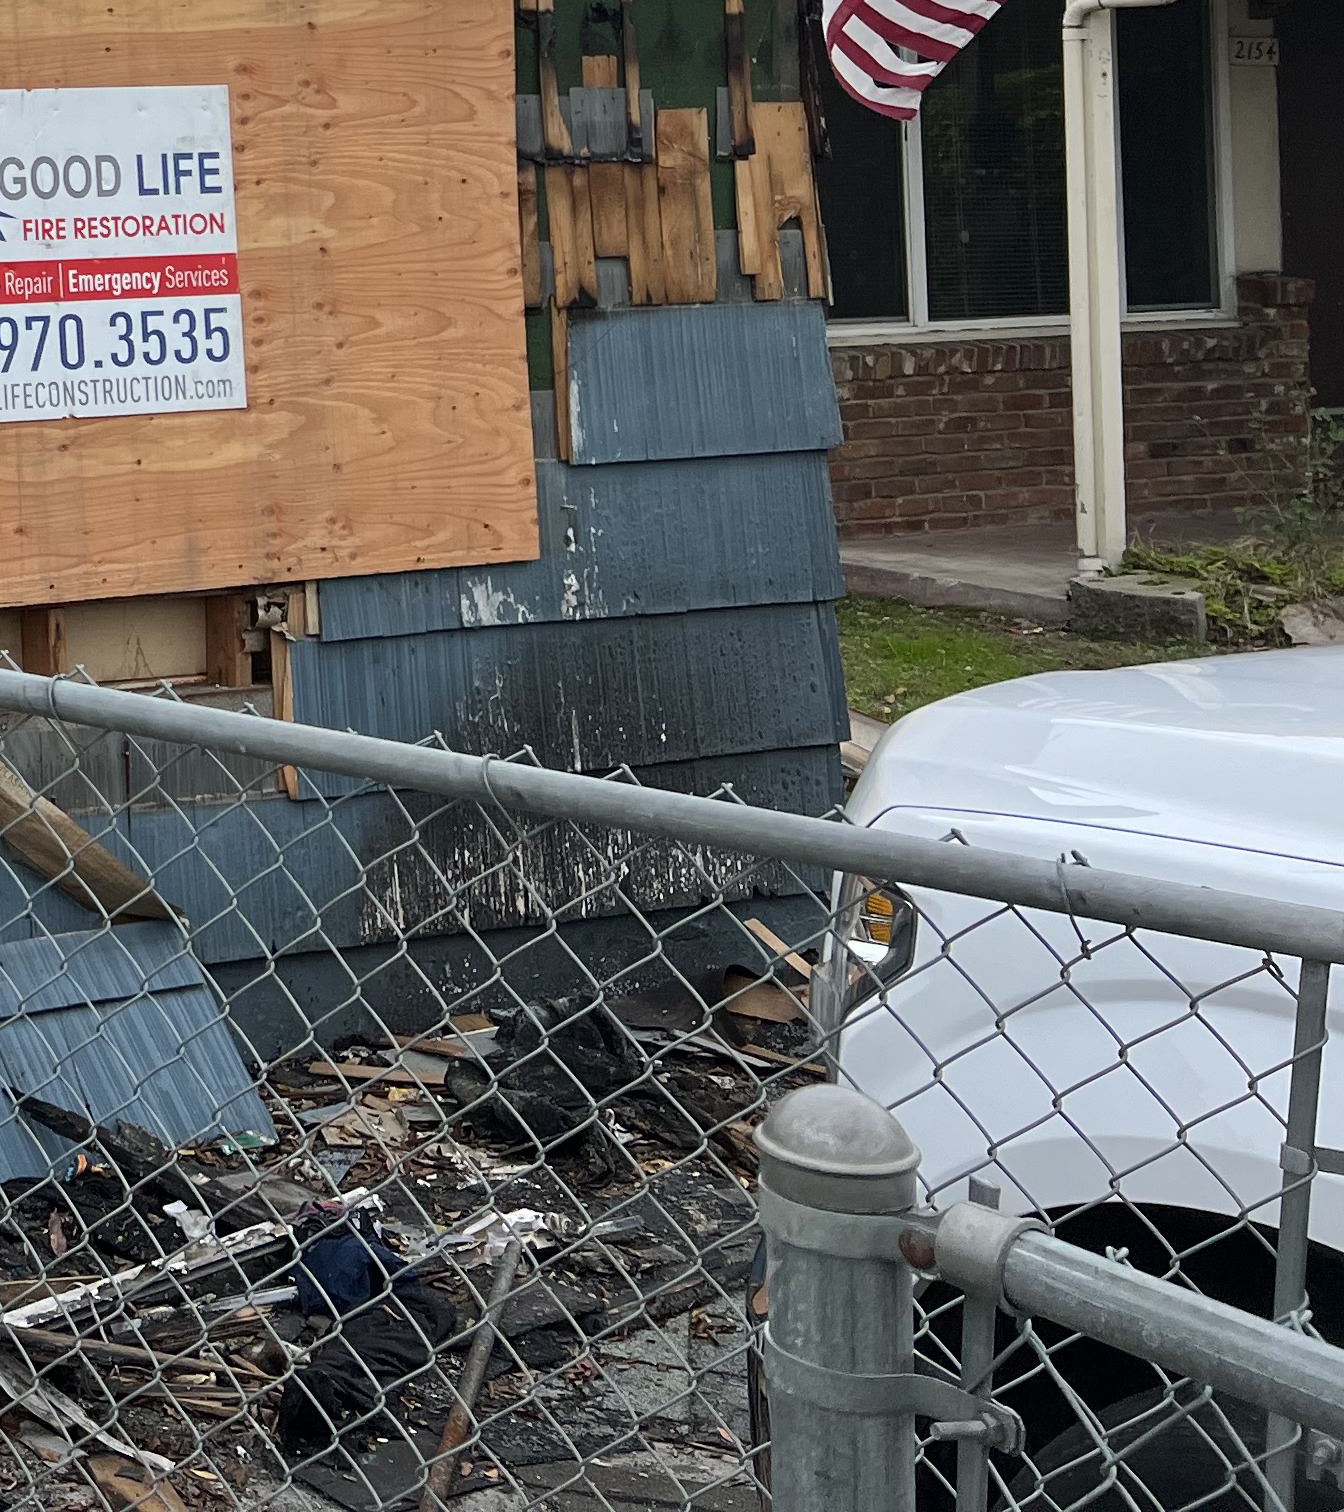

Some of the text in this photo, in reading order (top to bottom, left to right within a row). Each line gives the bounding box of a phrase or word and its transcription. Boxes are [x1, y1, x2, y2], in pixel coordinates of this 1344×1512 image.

[1234, 40, 1277, 61] 2154
[135, 151, 223, 196] LIFE
[22, 212, 226, 241] FIRE RESTORATION
[4, 271, 53, 300] Repair
[68, 269, 162, 296] Emergency
[165, 265, 229, 289] Services
